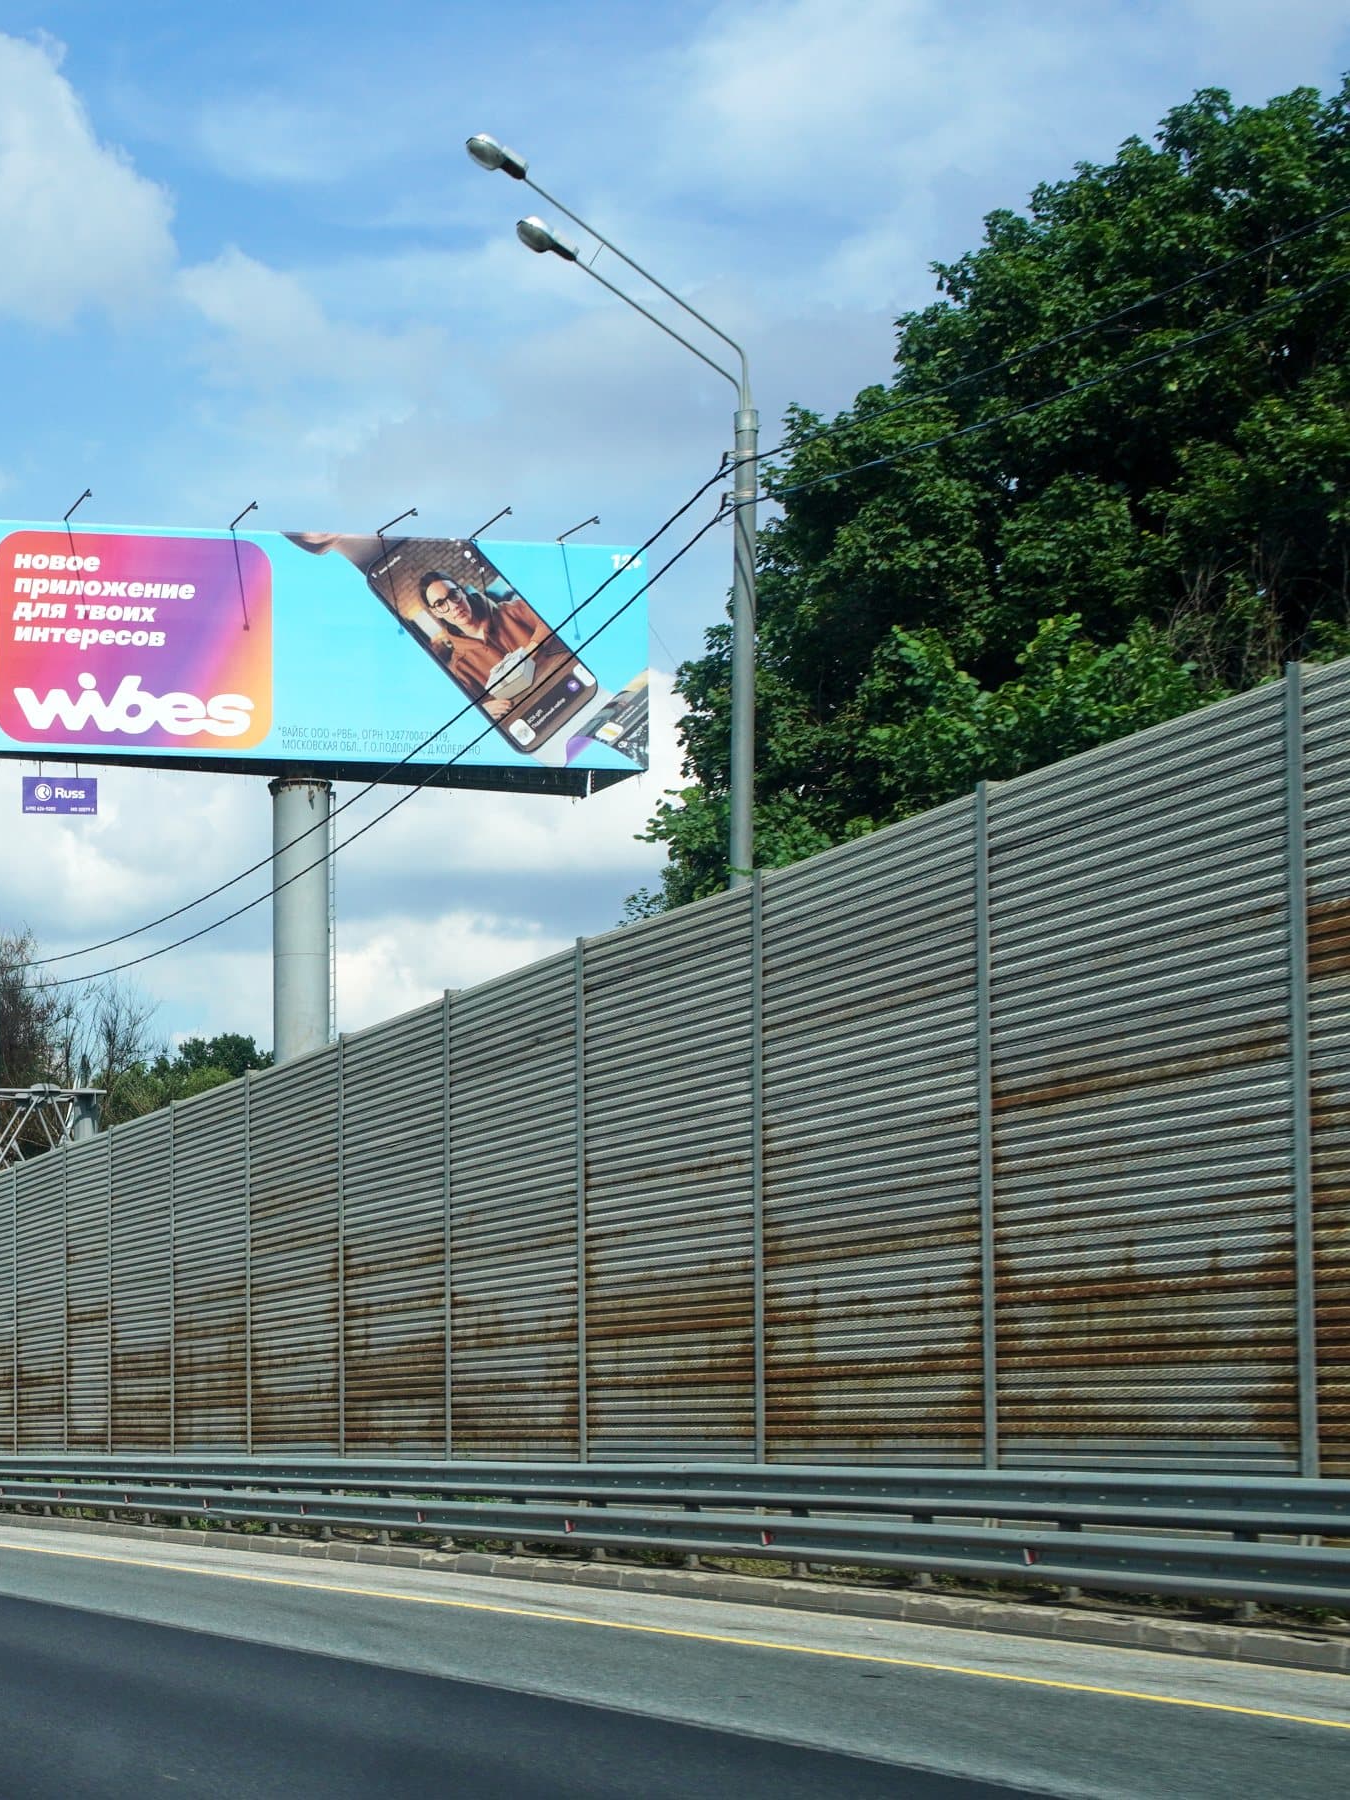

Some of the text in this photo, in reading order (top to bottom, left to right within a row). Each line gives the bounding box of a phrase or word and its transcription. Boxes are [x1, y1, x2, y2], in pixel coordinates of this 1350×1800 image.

[14, 553, 100, 572] новое
[14, 577, 196, 599] приложение
[12, 602, 157, 622] для твоих
[14, 625, 166, 650] интересов
[362, 729, 383, 740] ОГРН
[282, 739, 338, 751] МОСКОВСКАЯ
[55, 787, 86, 799] Russ
